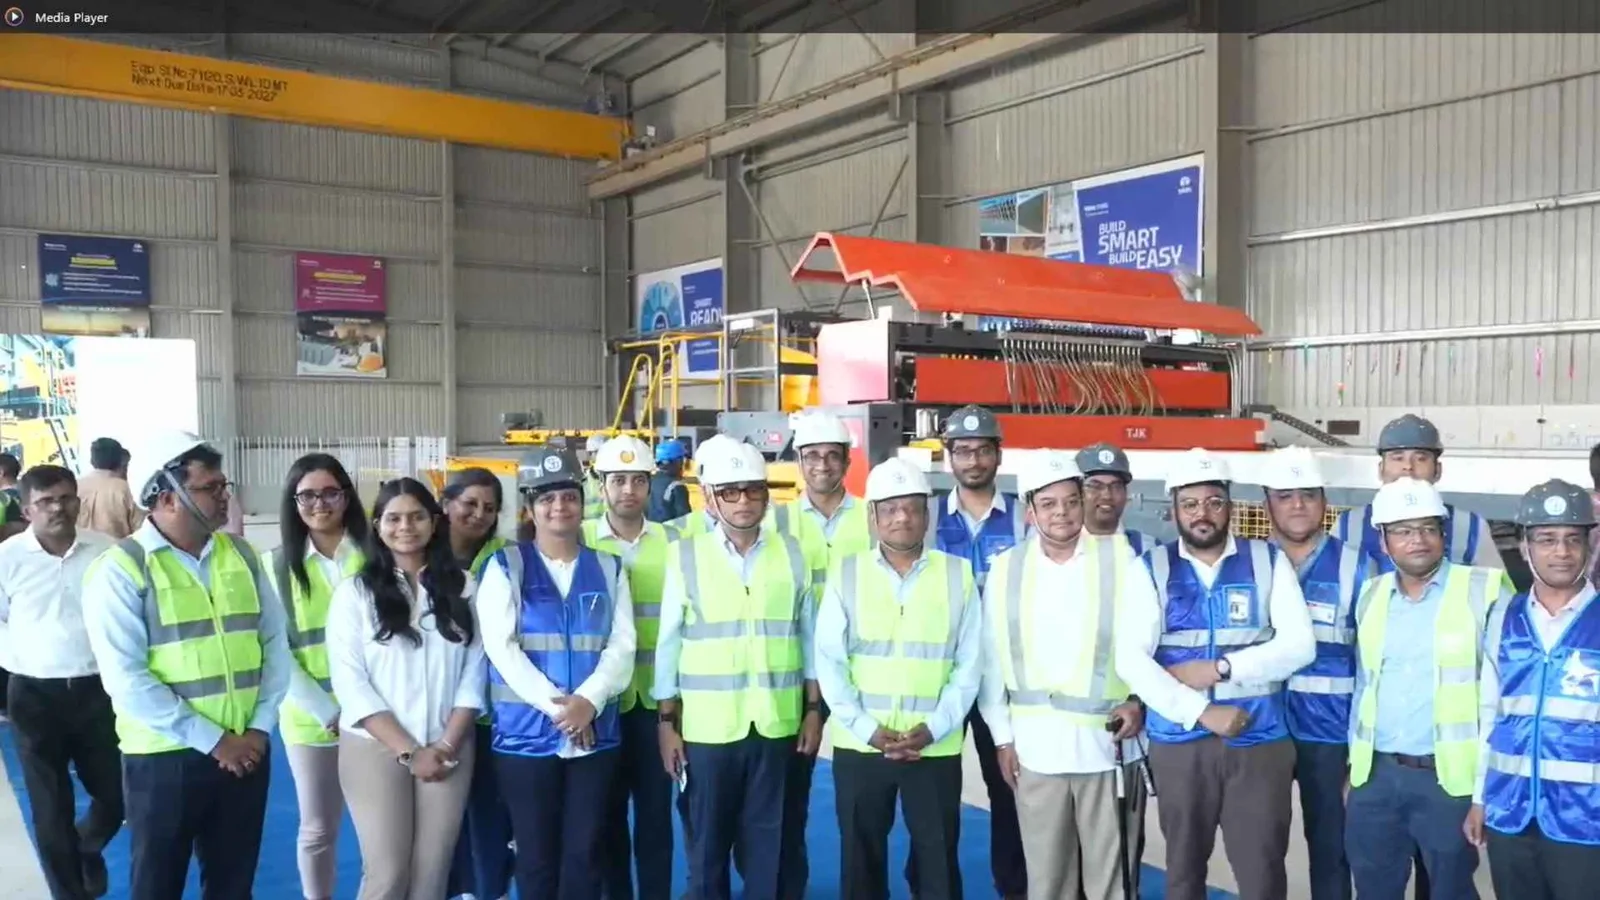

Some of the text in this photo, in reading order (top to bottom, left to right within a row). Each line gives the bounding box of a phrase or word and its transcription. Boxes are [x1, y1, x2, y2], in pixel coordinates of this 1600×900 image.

[131, 73, 161, 88] Next
[164, 77, 184, 91] Due
[1099, 220, 1126, 236] BUILD
[1098, 226, 1160, 255] SMART
[1109, 244, 1183, 270] BUILD EASY
[1126, 427, 1147, 439] TJK
